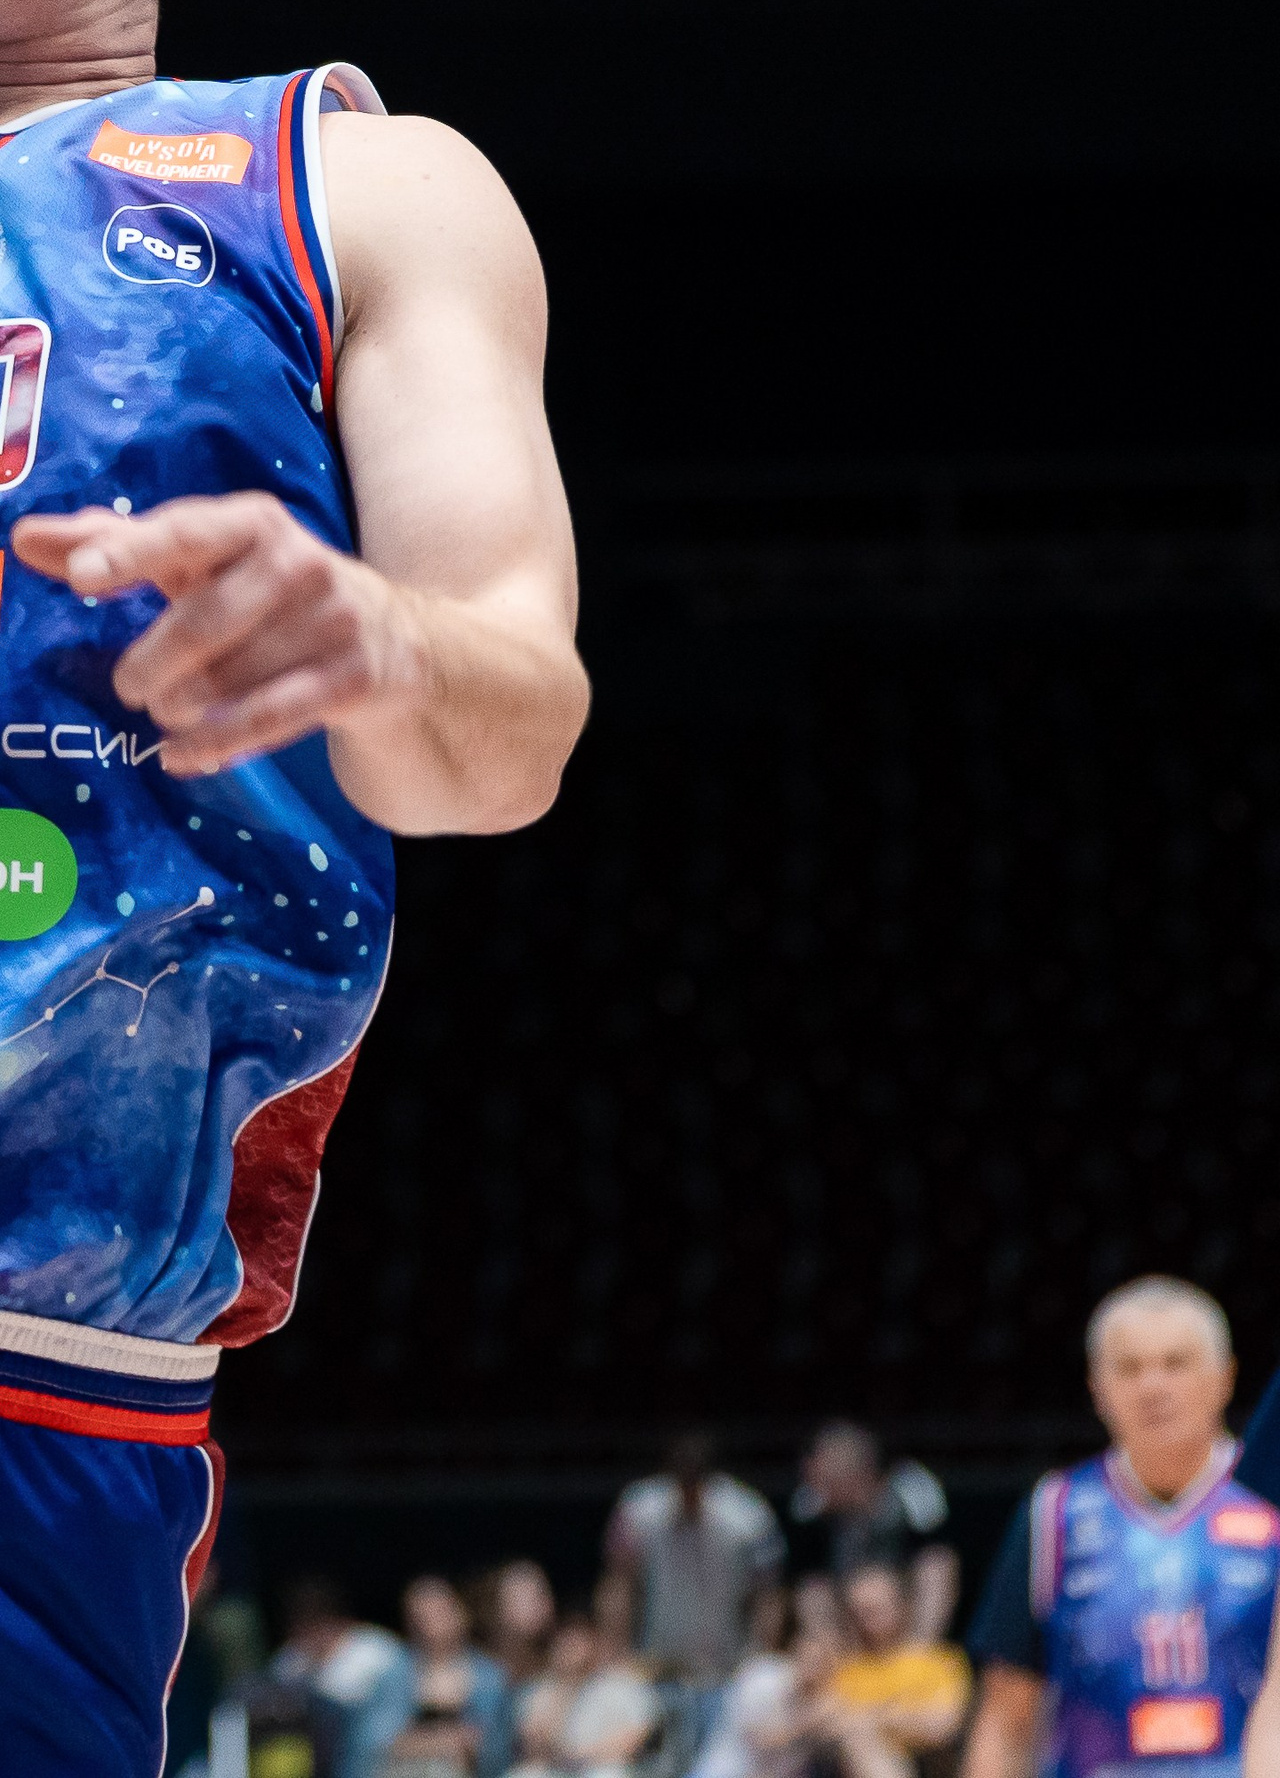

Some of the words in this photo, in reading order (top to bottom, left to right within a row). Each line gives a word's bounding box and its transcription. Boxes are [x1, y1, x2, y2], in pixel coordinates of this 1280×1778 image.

[128, 137, 216, 161] VYSOTA
[99, 153, 234, 179] DEVELOPMENT
[117, 227, 202, 271] РФБ
